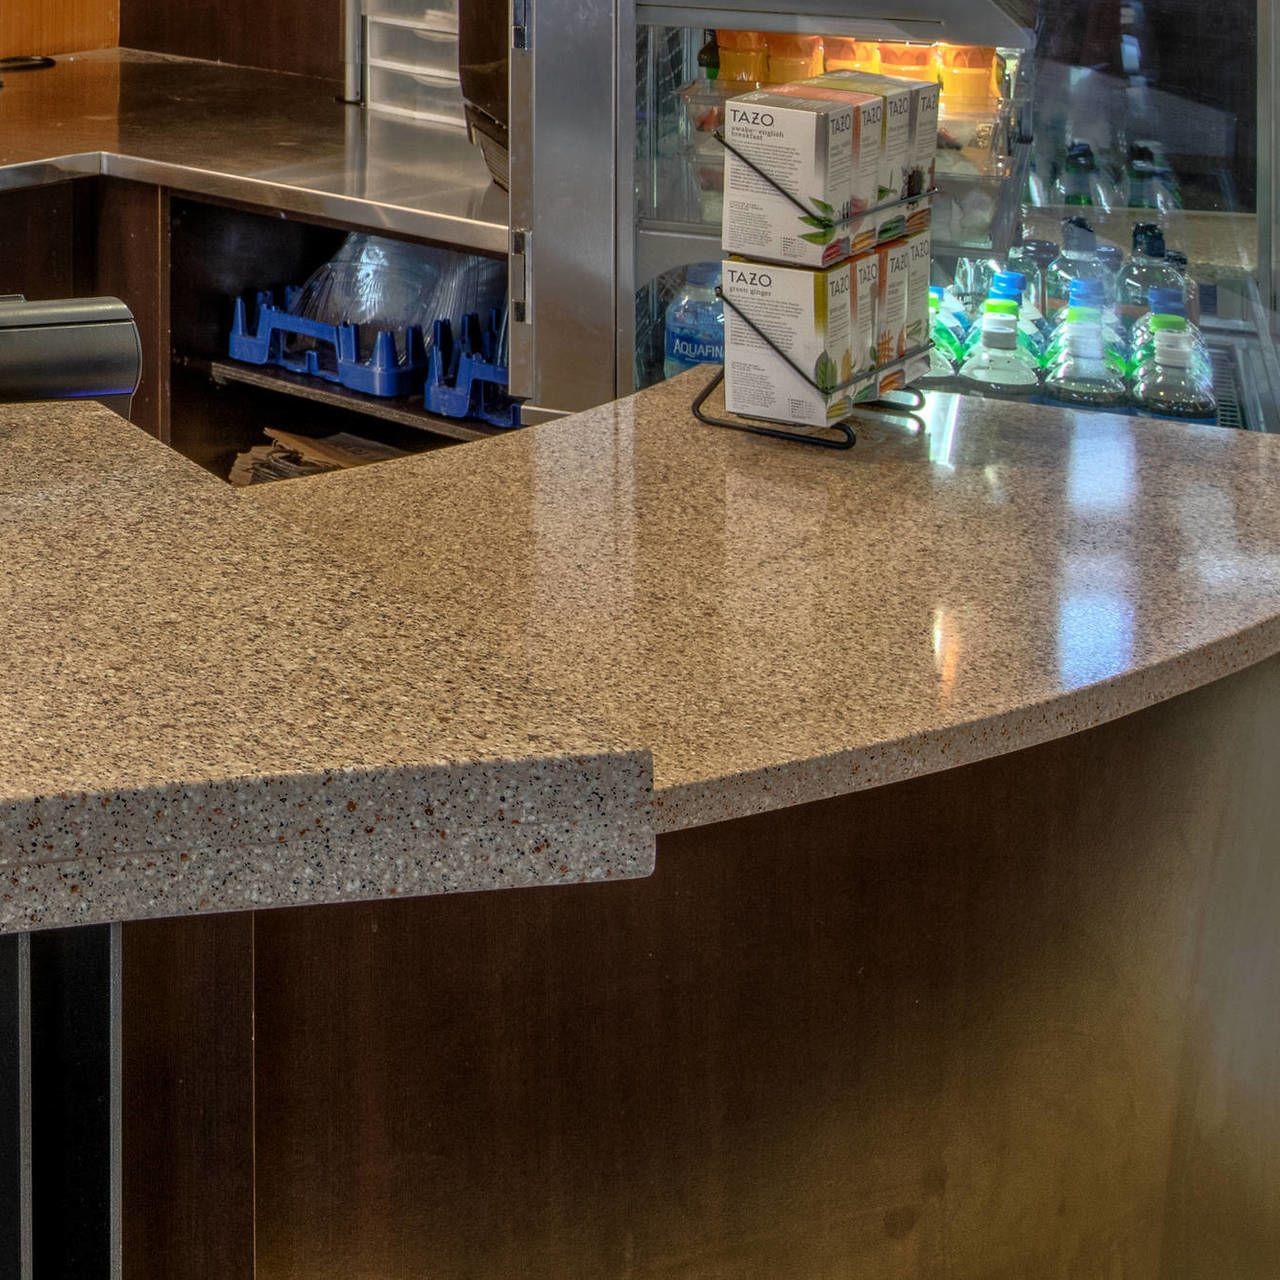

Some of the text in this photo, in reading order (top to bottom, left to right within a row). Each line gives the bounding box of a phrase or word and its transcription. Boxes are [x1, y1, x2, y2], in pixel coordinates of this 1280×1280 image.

[862, 104, 882, 126] TAZO
[889, 95, 909, 118] TAZO
[730, 109, 774, 127] TAZO
[830, 112, 850, 135] TAZO
[910, 239, 929, 260] TAZO
[728, 269, 772, 287] TAZO
[858, 263, 878, 282] TAZO
[830, 274, 849, 297] TAZO
[673, 339, 725, 359] AQUAFIN
